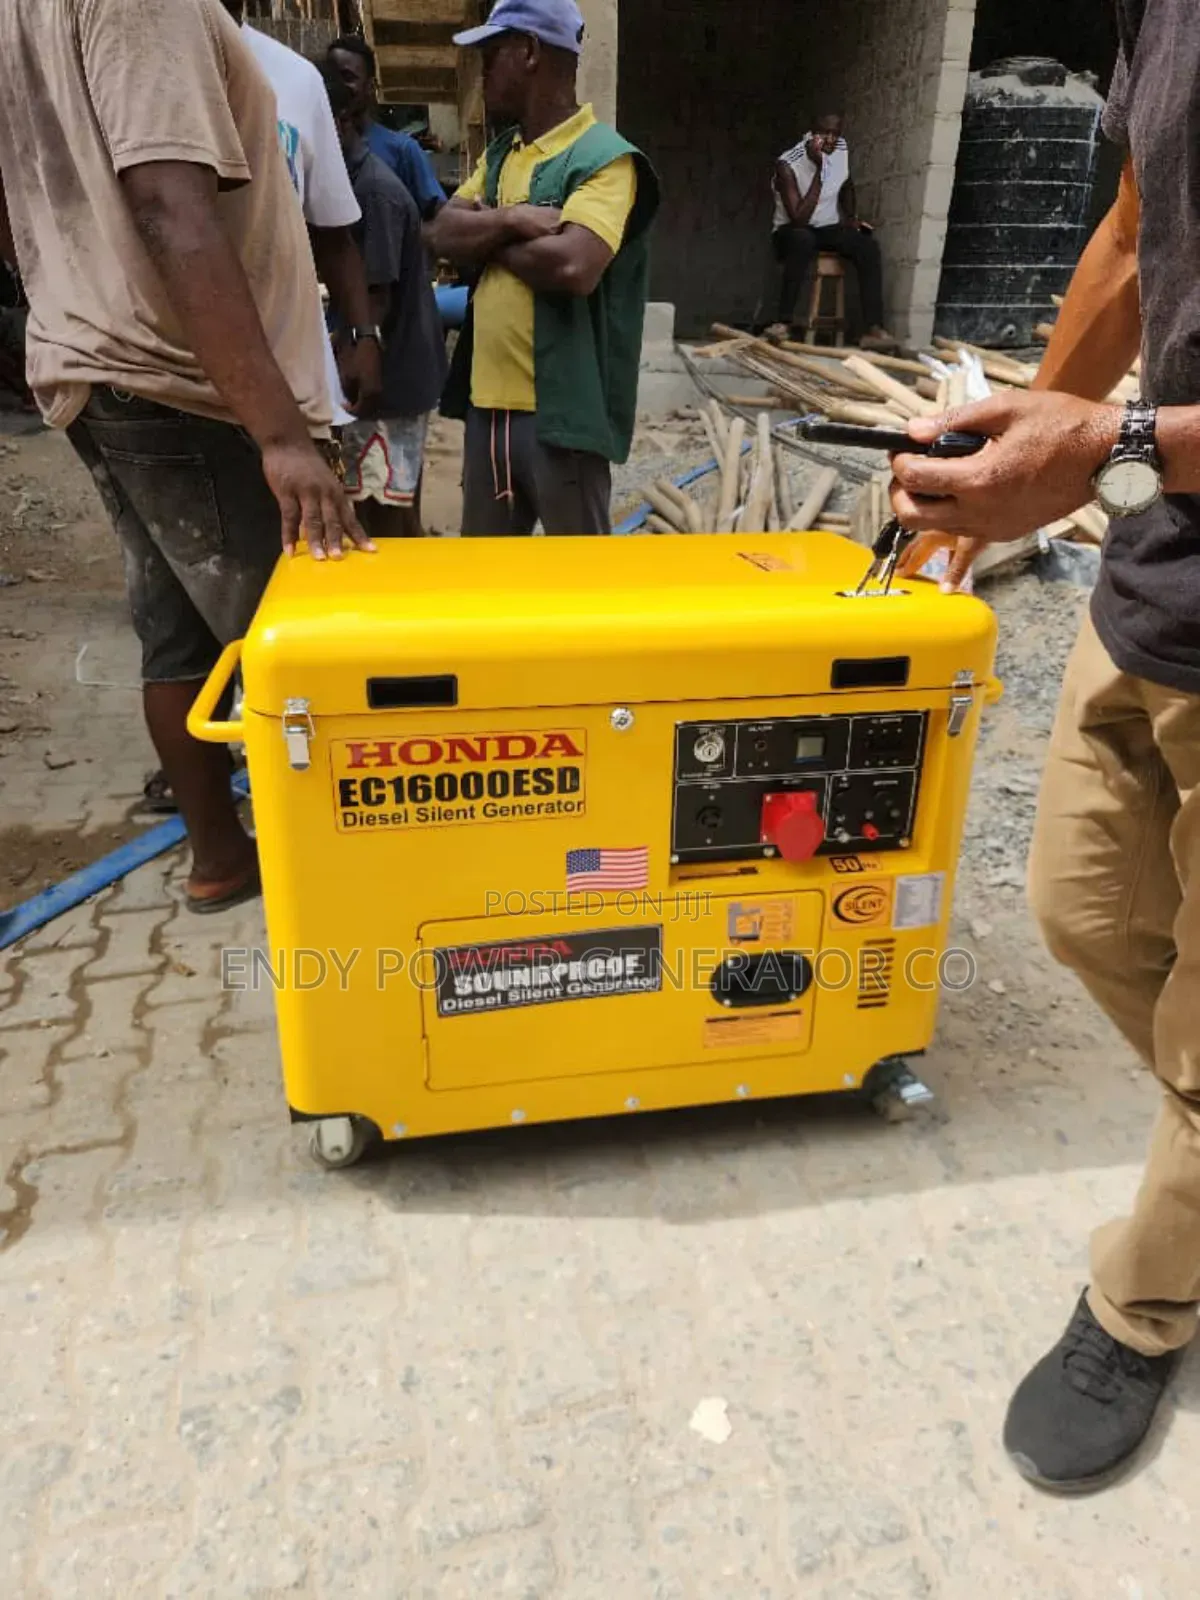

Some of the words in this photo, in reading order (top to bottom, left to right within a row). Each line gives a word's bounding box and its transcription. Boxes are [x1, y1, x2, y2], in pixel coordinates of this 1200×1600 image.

[346, 733, 583, 769] HONDA
[339, 766, 581, 808] EC16000ESD
[342, 803, 409, 828] Diesel
[415, 804, 476, 824] Silent
[482, 798, 585, 820] Generator
[833, 858, 860, 872] 50
[844, 898, 883, 911] SILENT
[443, 990, 502, 1011] Diesel
[508, 987, 562, 1004] Silent
[568, 976, 660, 995] Generator
